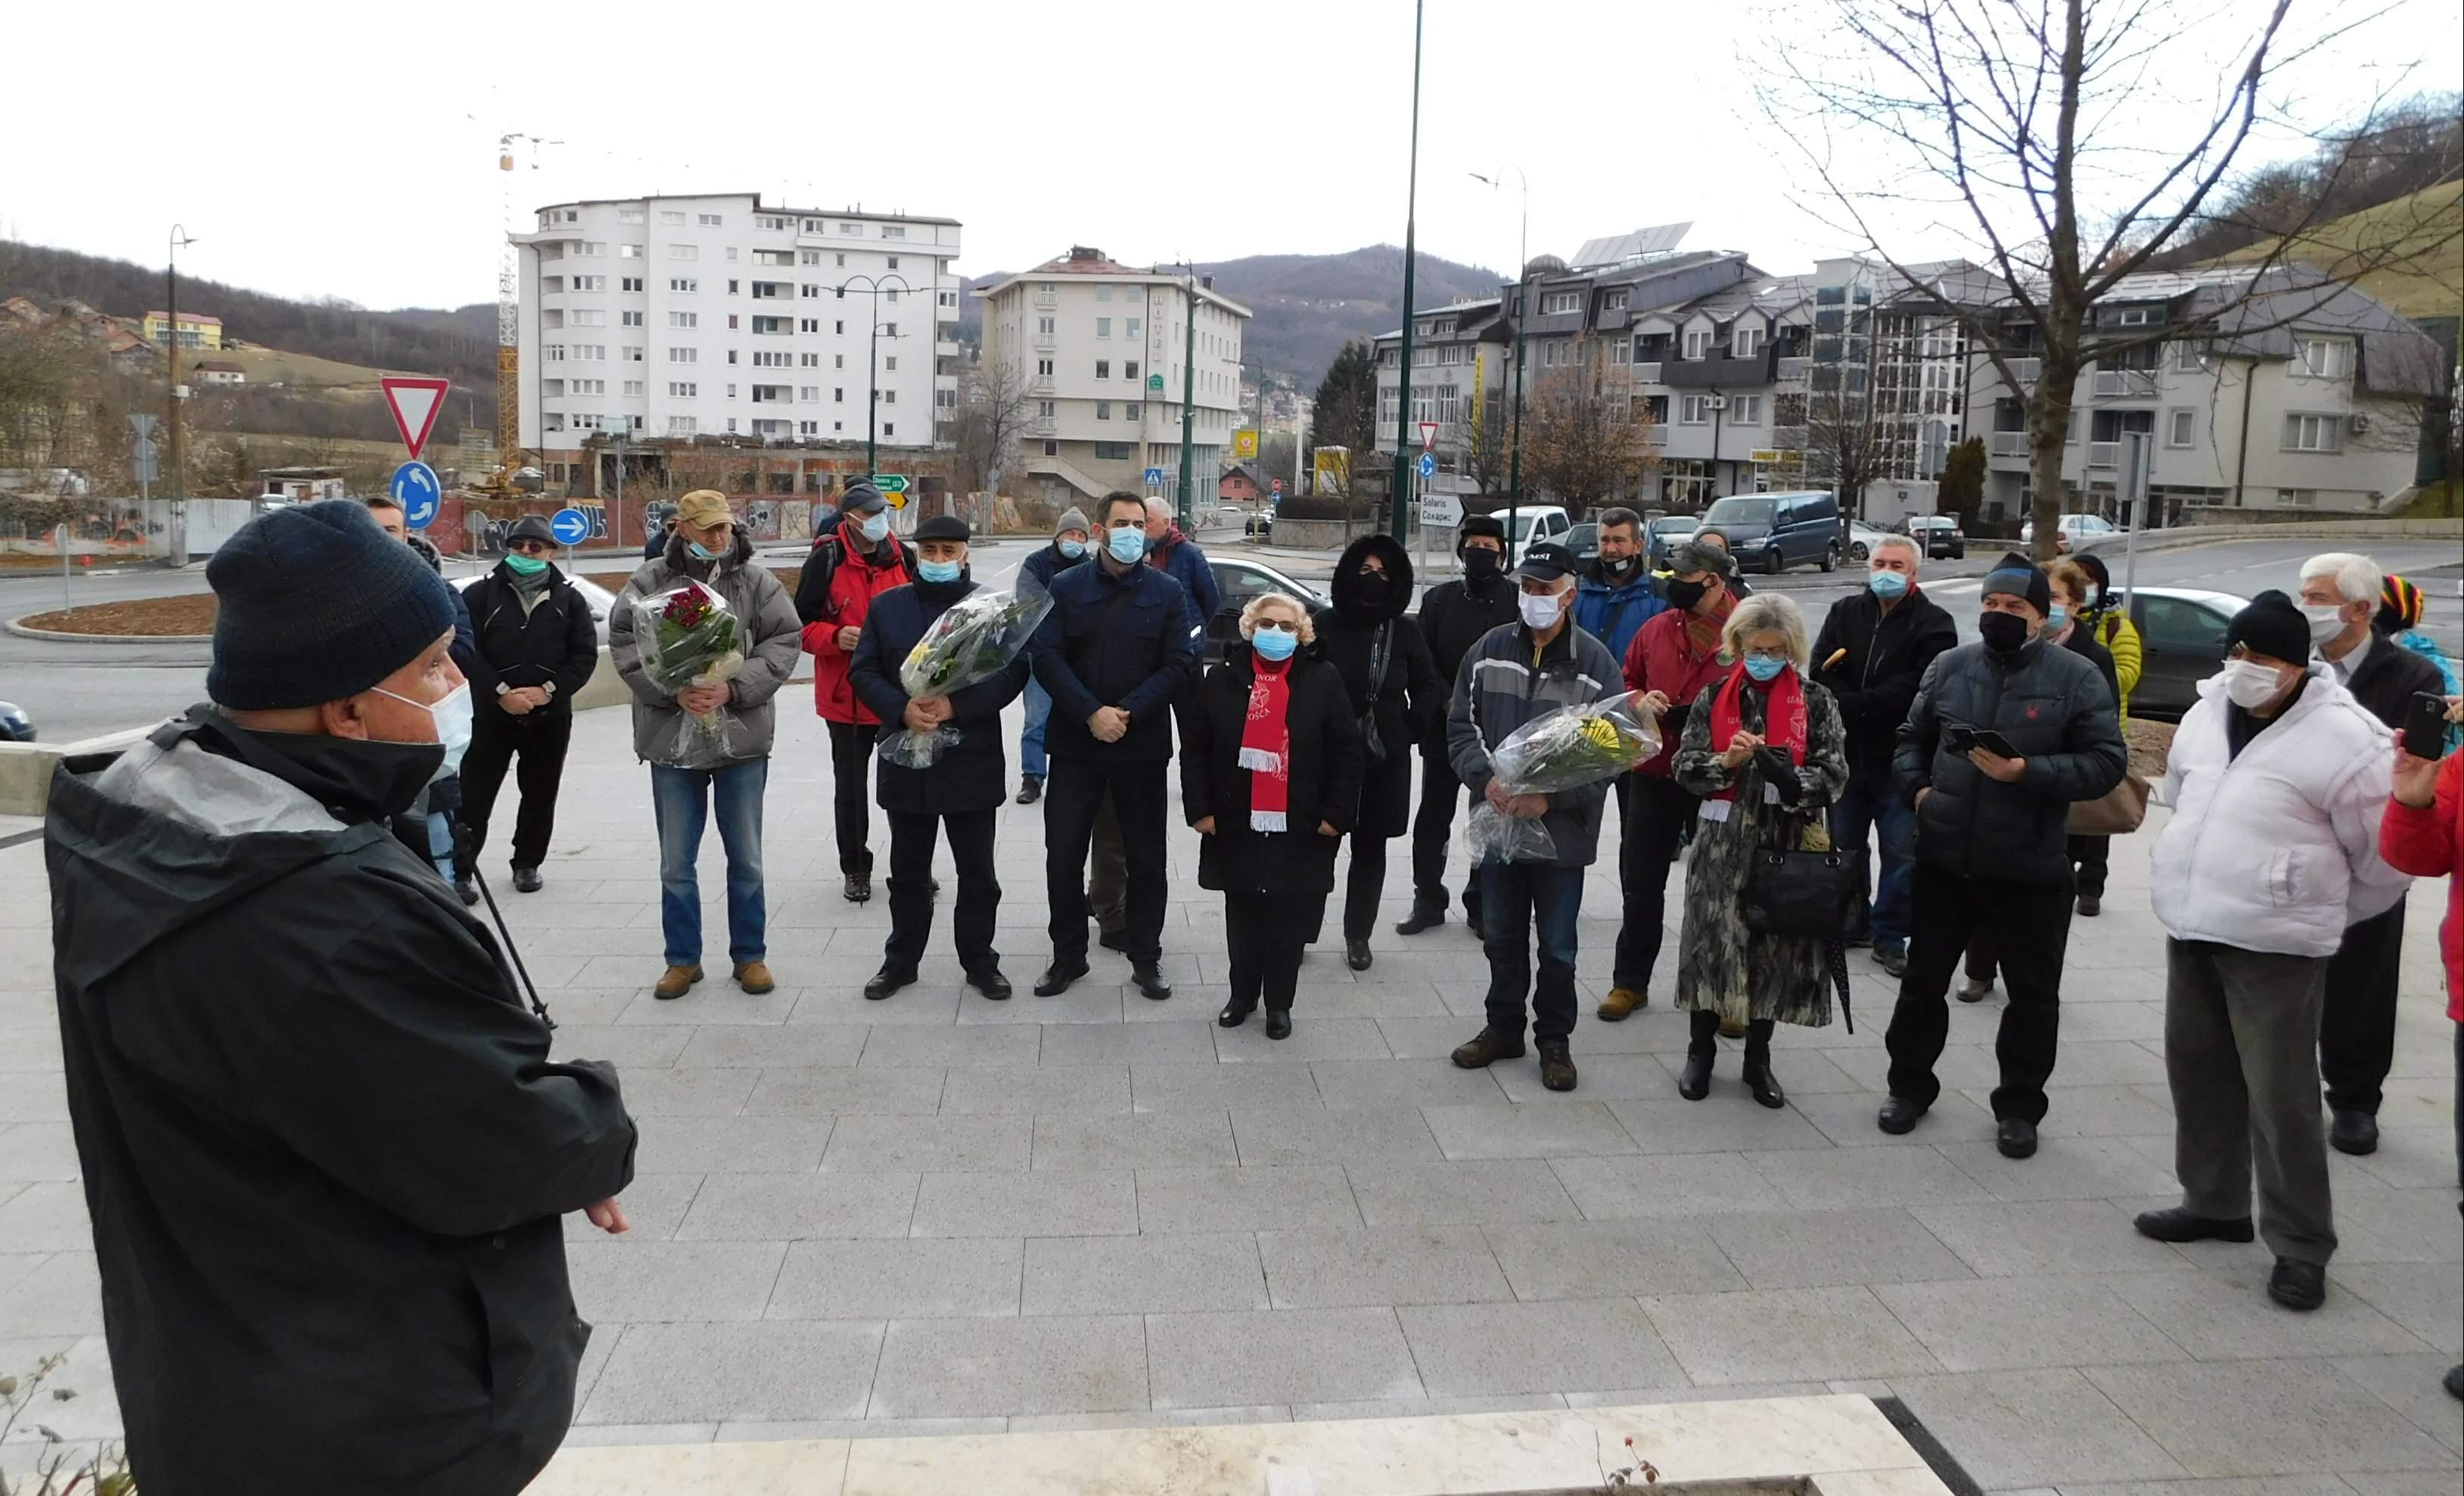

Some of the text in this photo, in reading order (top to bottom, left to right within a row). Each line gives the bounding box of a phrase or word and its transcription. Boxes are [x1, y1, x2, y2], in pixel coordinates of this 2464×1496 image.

[1153, 294, 1163, 362] HOTEL
[1423, 497, 1446, 507] Solaris
[1422, 511, 1452, 523] Соларис
